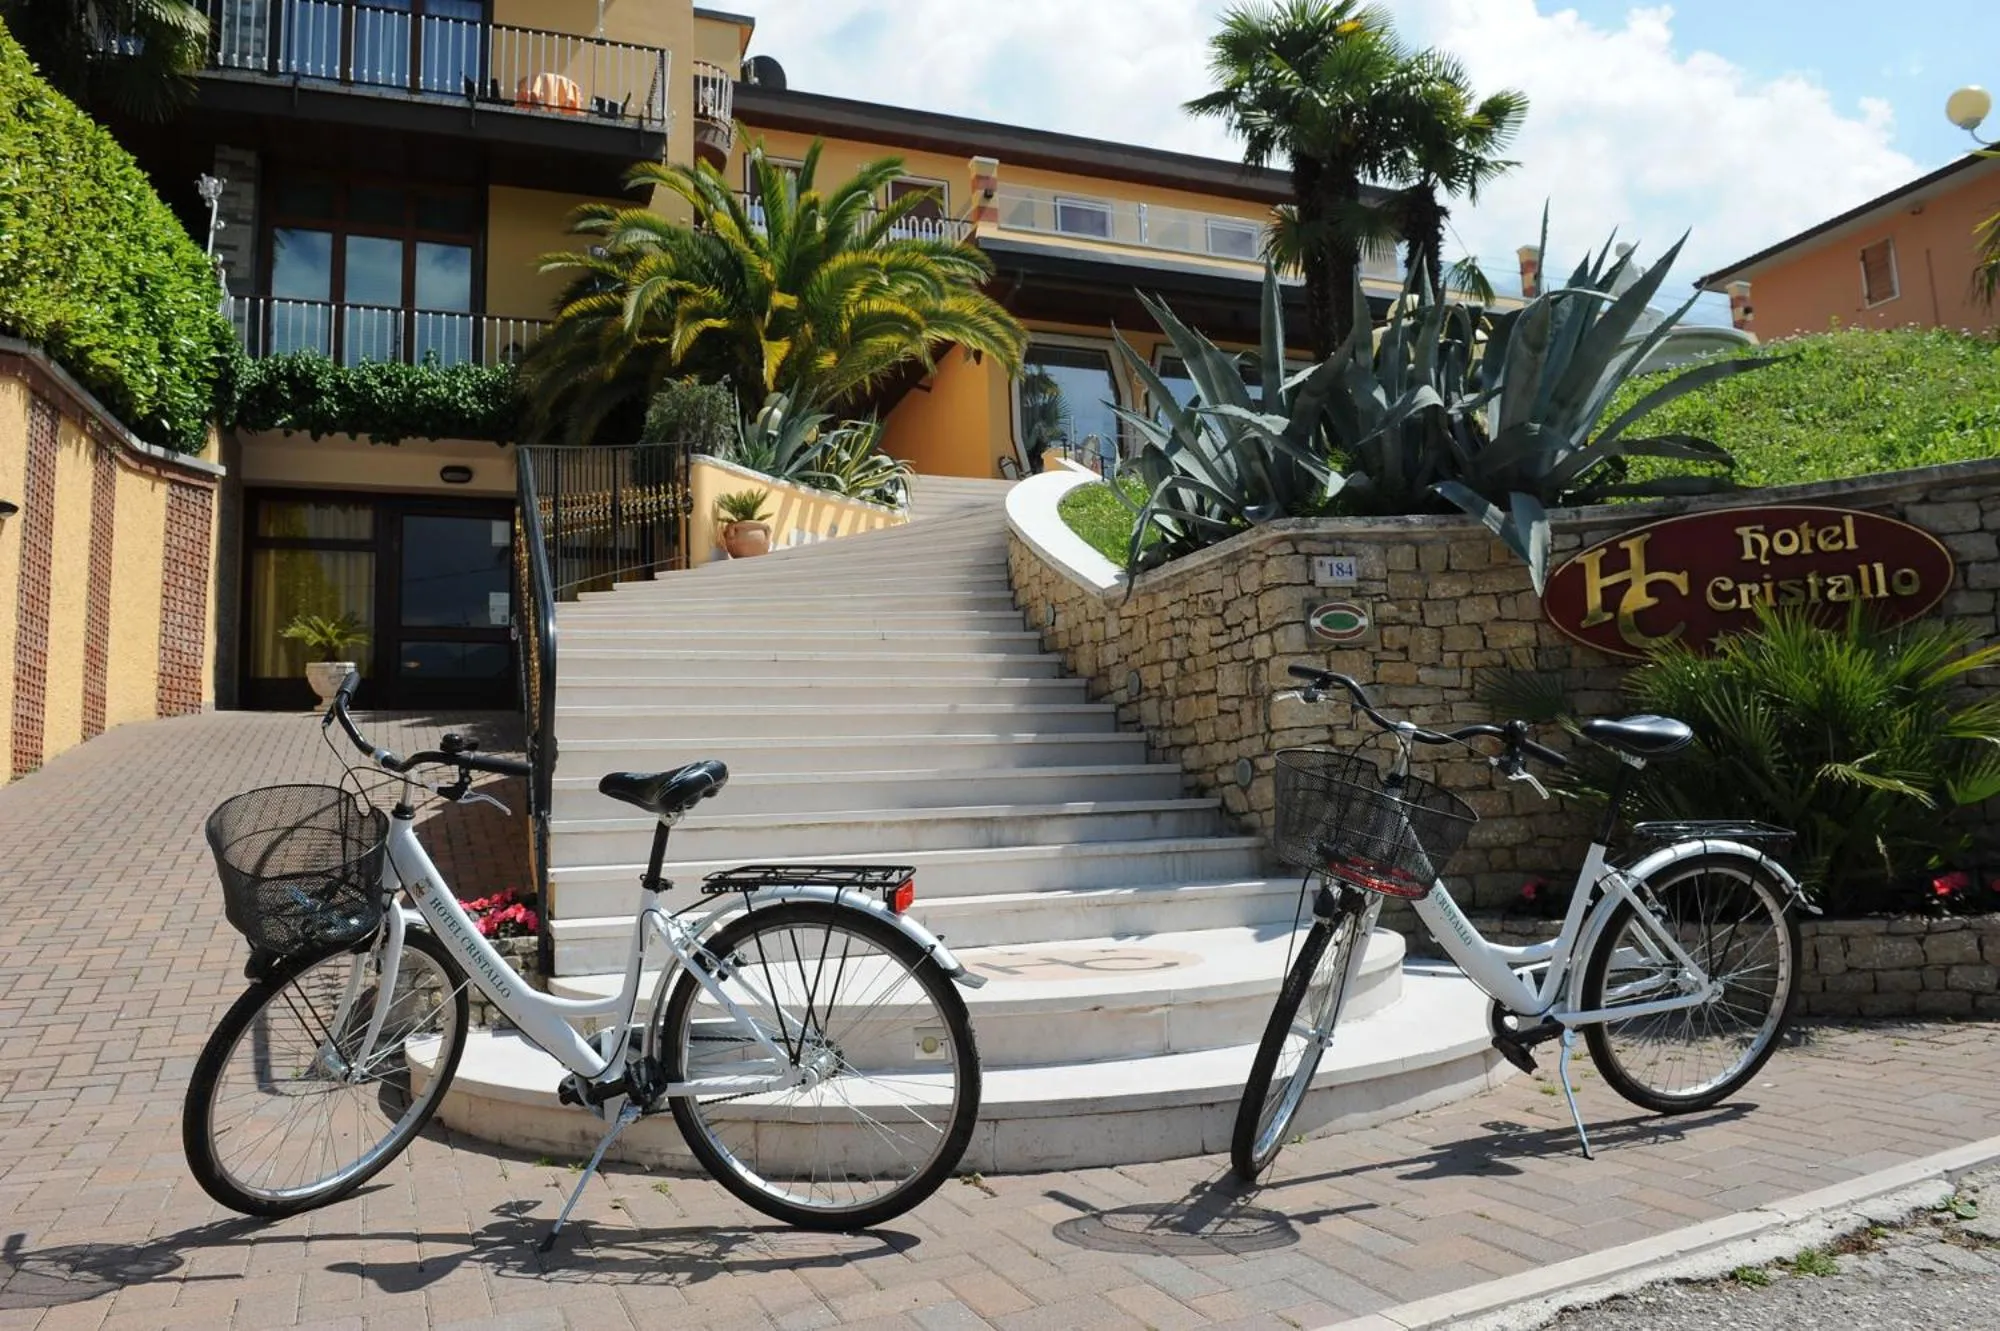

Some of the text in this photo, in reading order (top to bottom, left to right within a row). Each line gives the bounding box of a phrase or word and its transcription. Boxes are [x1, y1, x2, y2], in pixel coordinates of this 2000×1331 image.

[1327, 561, 1354, 577] 184
[429, 897, 512, 999] HOTEL CRISTALLO
[1435, 891, 1473, 948] CRISTALLO
